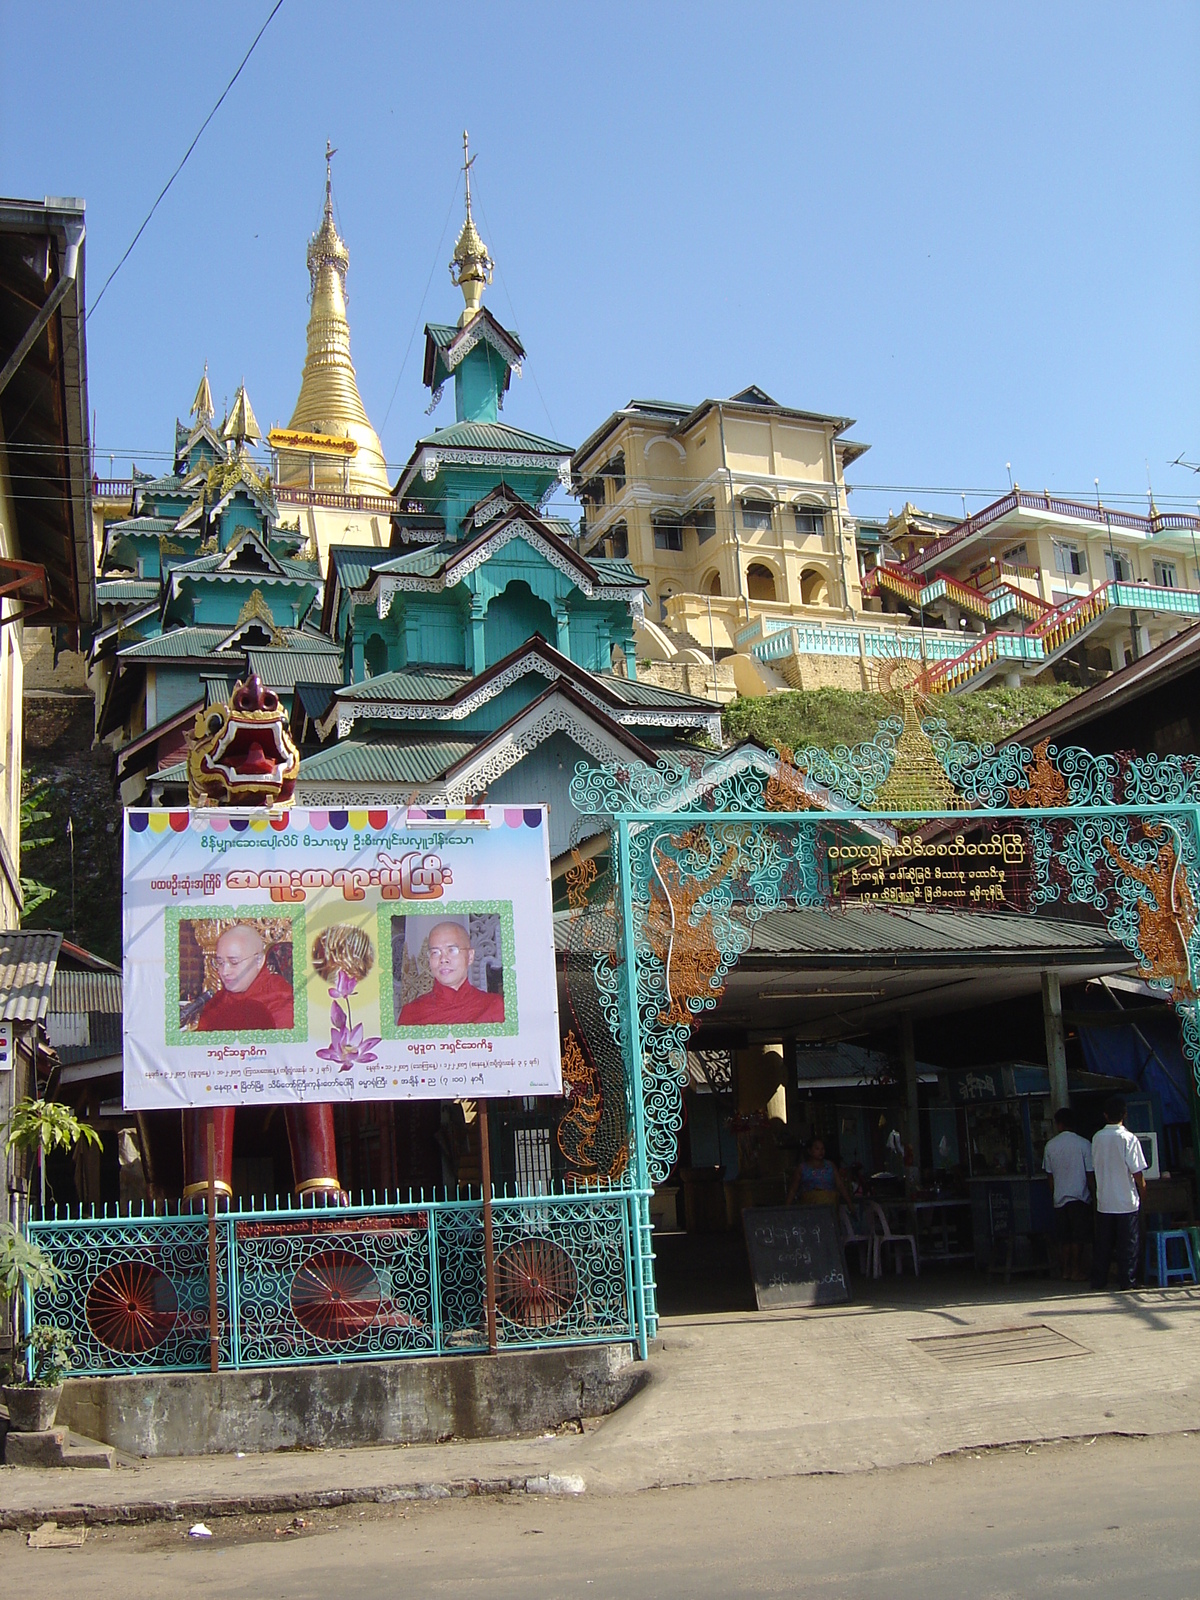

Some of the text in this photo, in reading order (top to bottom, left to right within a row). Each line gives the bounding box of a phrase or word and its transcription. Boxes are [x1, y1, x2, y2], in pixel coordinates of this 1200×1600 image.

[200, 832, 474, 853] စိန်မျှားဆေးပေါ့လိပ် မိသားစုမှ ဦးစီးကျင်းပလှူဒါန်းသော
[828, 834, 1026, 867] လေးကျွန်းဆီမီးစေတီတော်ကြီး
[226, 851, 454, 903] အထူးတရားပွဲကြီး
